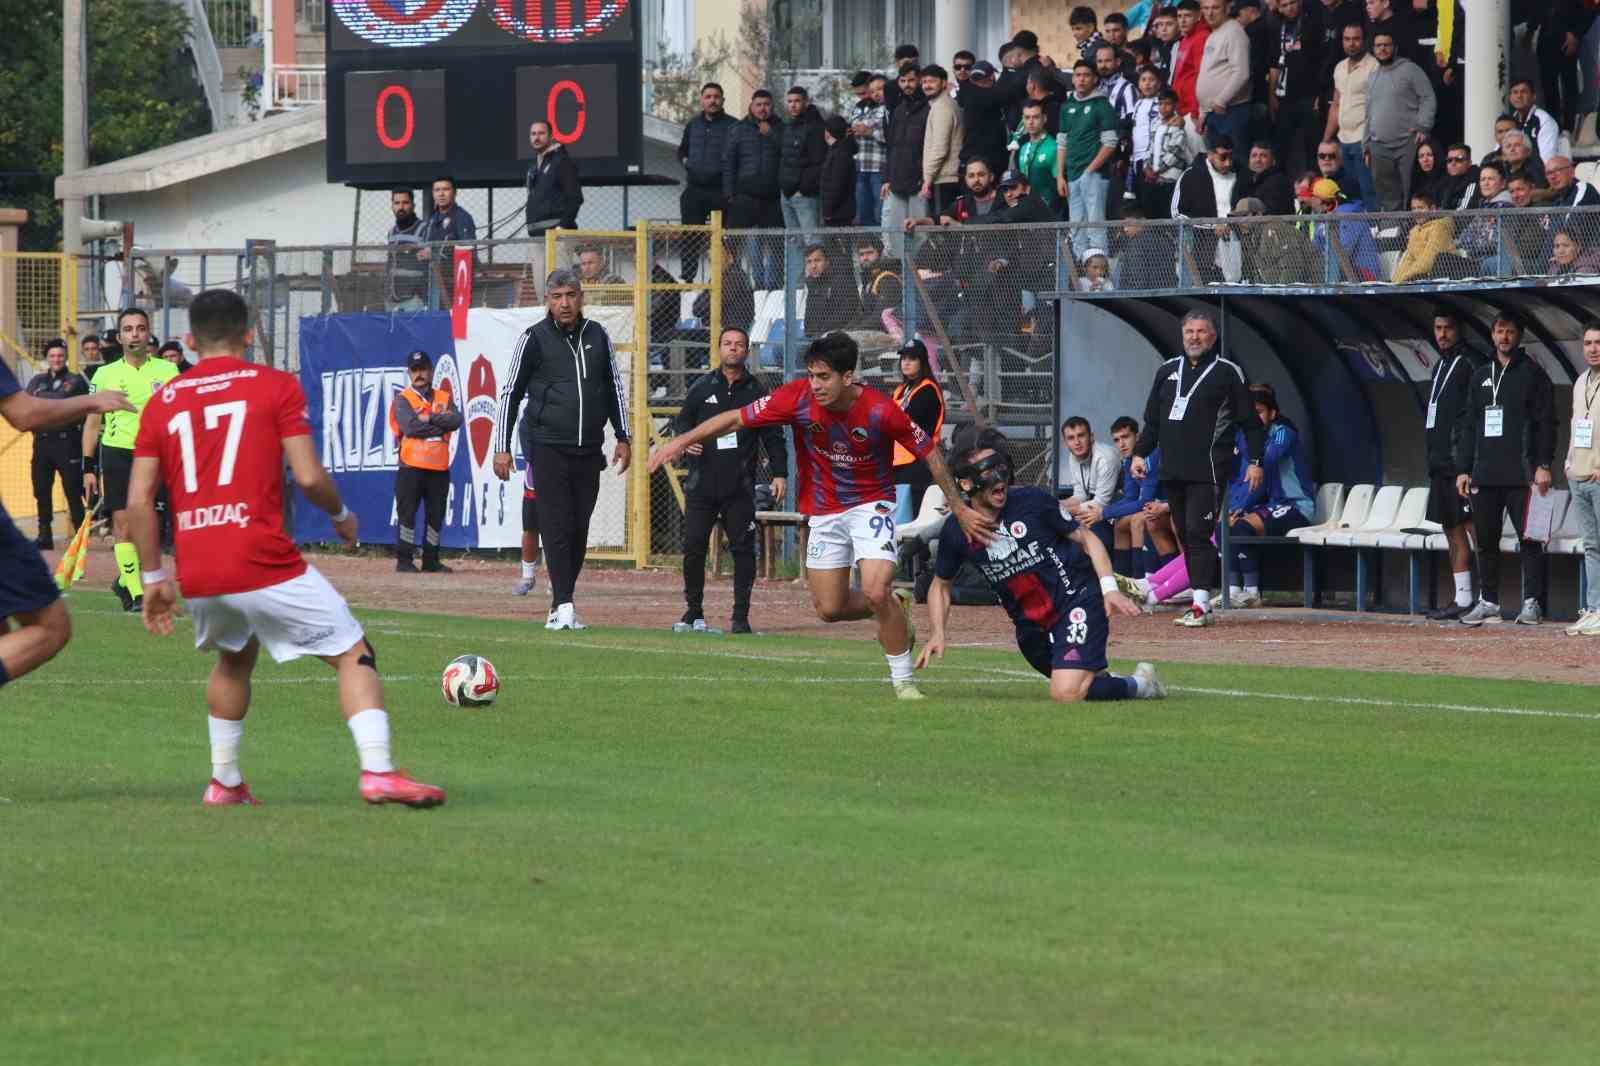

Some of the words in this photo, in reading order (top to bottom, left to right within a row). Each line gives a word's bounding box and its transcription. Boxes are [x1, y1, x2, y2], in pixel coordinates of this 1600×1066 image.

[375, 85, 414, 149] 0
[547, 80, 586, 145] 0
[320, 366, 411, 473] KUZE
[167, 400, 248, 494] 17
[176, 502, 251, 532] YILDIZAÇ
[389, 482, 506, 527] ACHES
[869, 516, 896, 540] 99
[981, 540, 1041, 576] ESNAF
[1066, 622, 1088, 645] 33
